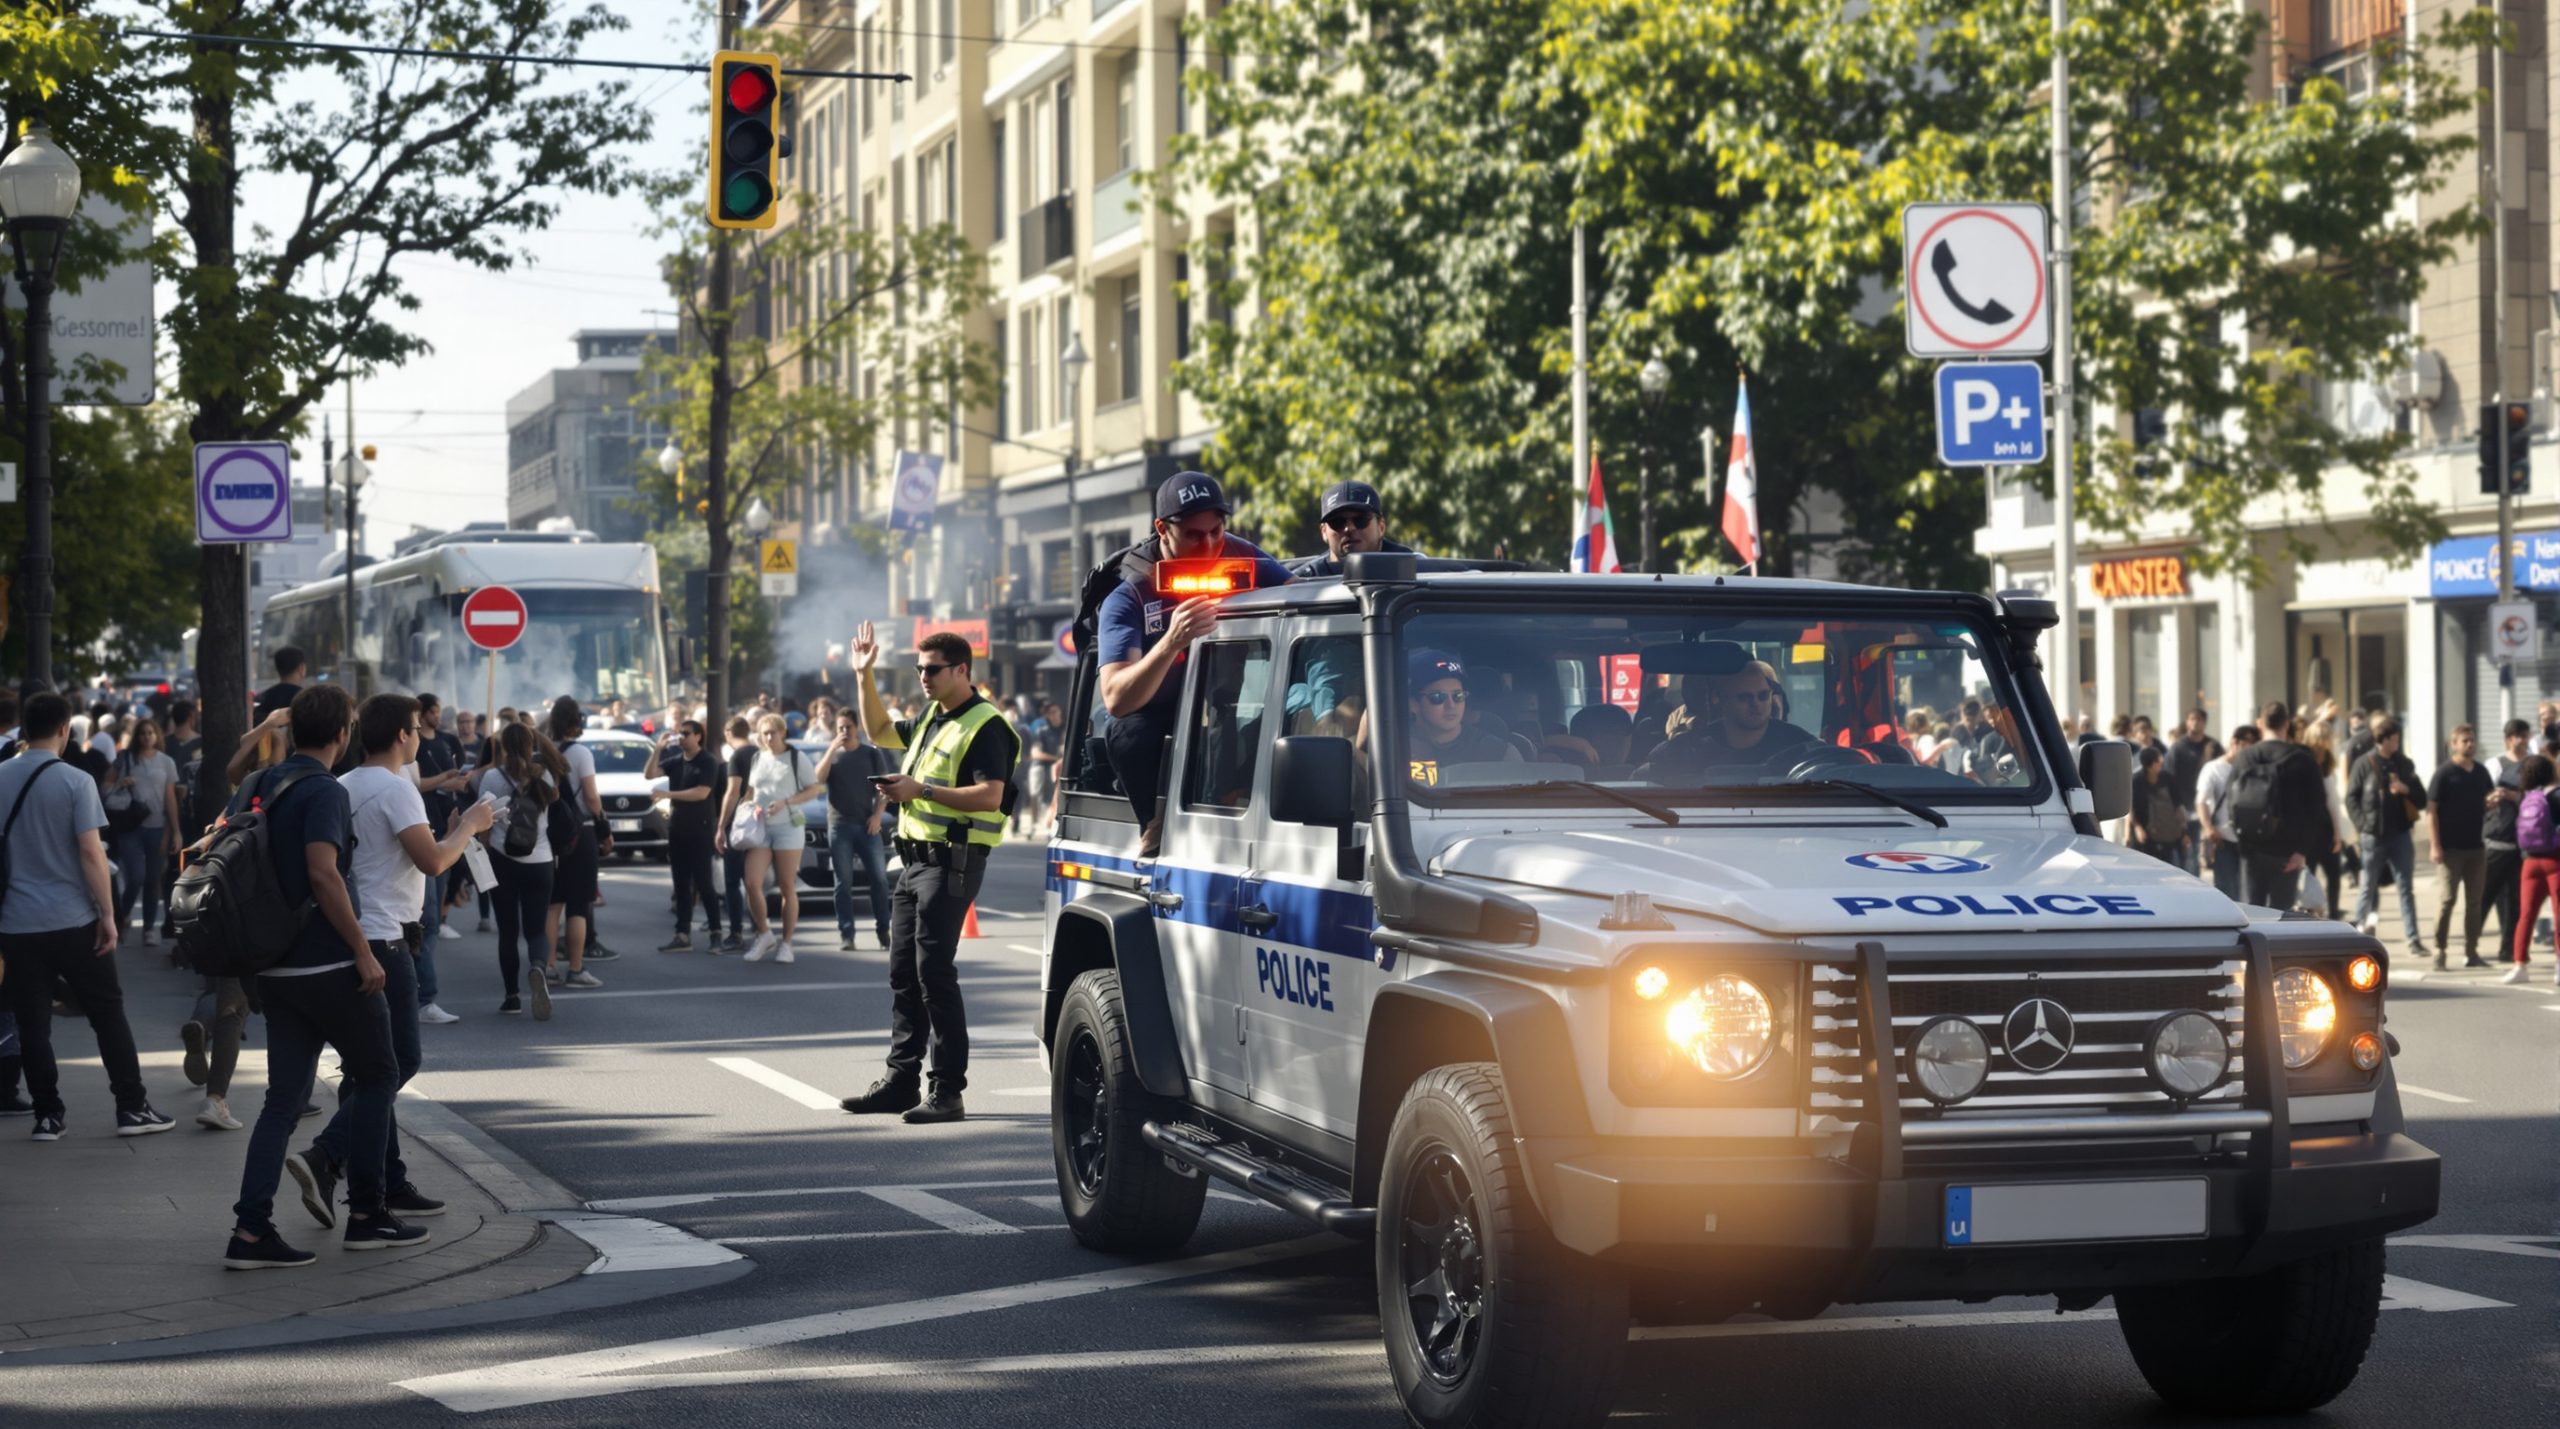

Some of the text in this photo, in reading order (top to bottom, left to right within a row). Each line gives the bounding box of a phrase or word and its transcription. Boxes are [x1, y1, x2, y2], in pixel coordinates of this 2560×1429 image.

[2091, 556, 2184, 597] CANSTER
[1831, 894, 2156, 917] POLICE
[1256, 946, 1335, 1013] POLICE
